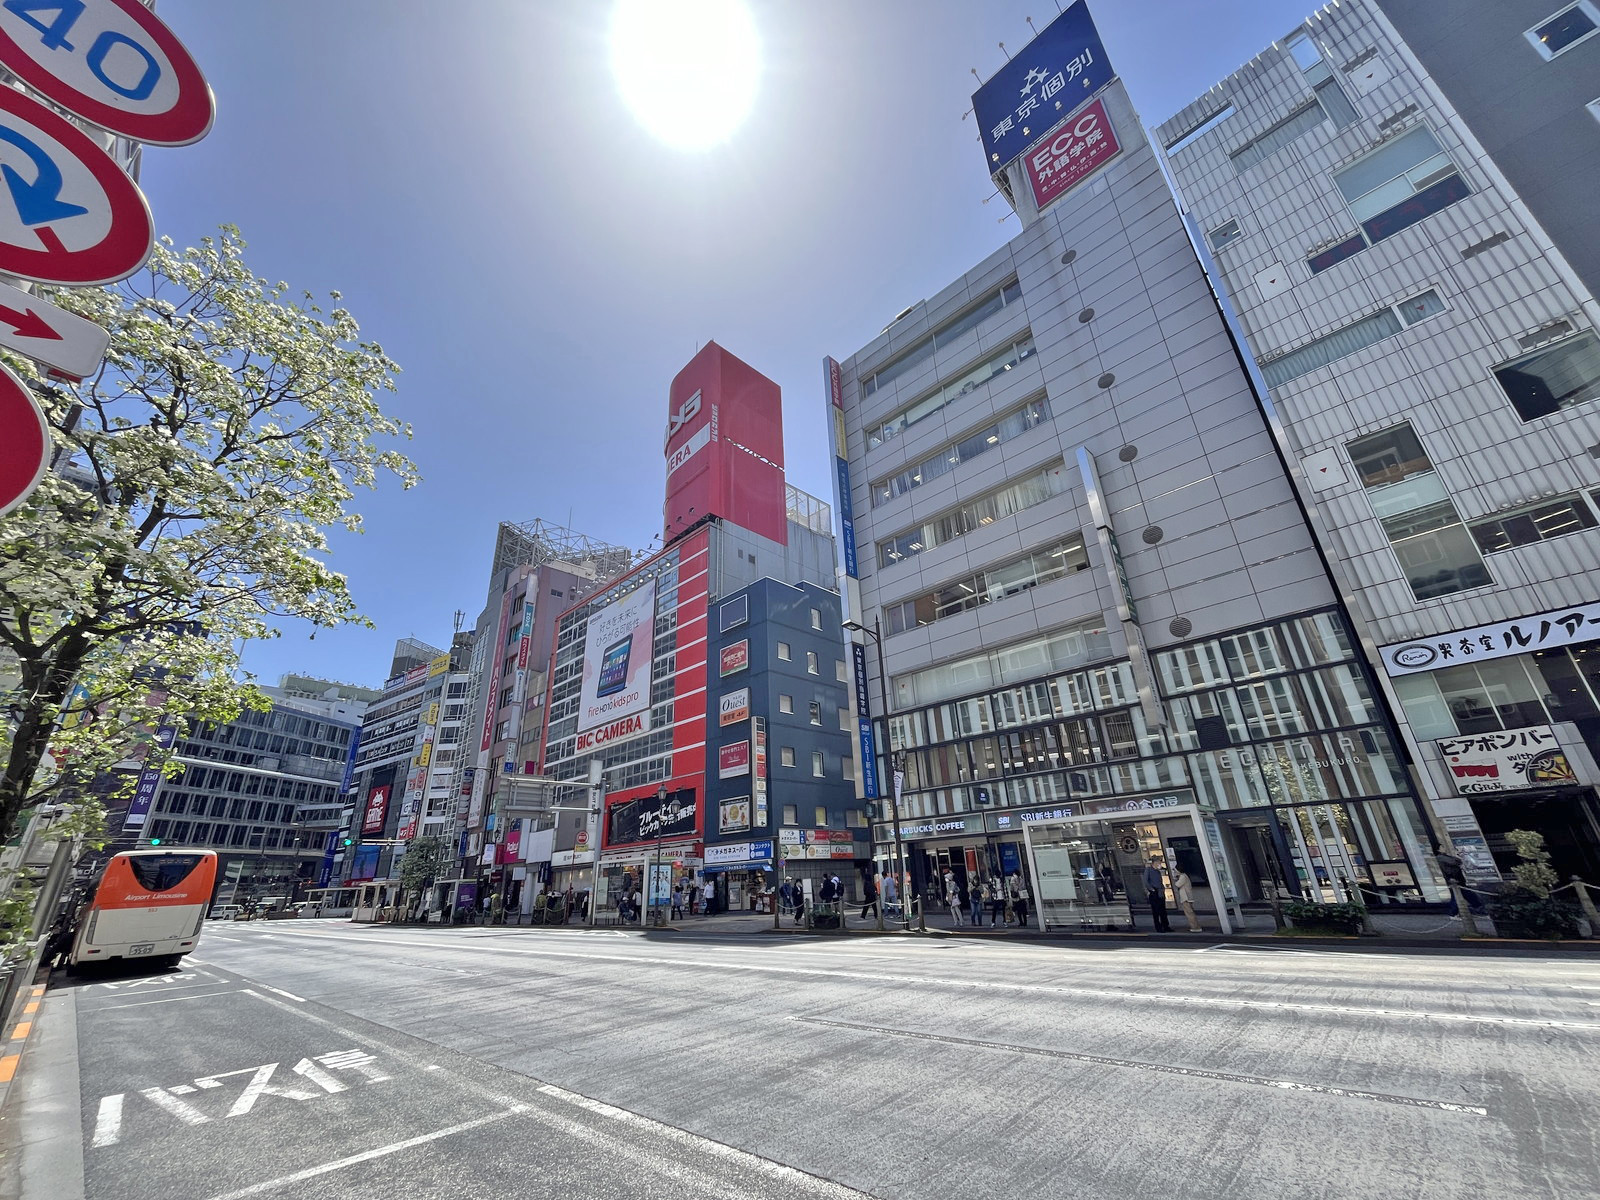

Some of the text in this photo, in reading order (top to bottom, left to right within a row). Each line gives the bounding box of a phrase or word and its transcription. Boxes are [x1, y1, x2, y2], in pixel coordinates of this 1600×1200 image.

[4, 0, 161, 101] 40
[991, 48, 1094, 143] 東京個別
[1032, 113, 1098, 172] ECC
[1038, 127, 1104, 184] 外語学院
[485, 666, 499, 742] ハウスメイト
[626, 691, 639, 706] pro
[576, 715, 643, 750] BIC CAMERA
[1439, 729, 1553, 756] ビアポンバー
[1507, 752, 1534, 761] with
[1512, 759, 1554, 774] ダーツ
[890, 821, 965, 836] SARBUCKS COFFEE
[998, 816, 1010, 824] SBI
[719, 846, 747, 855] メガネスーパー
[124, 894, 151, 902] Airport
